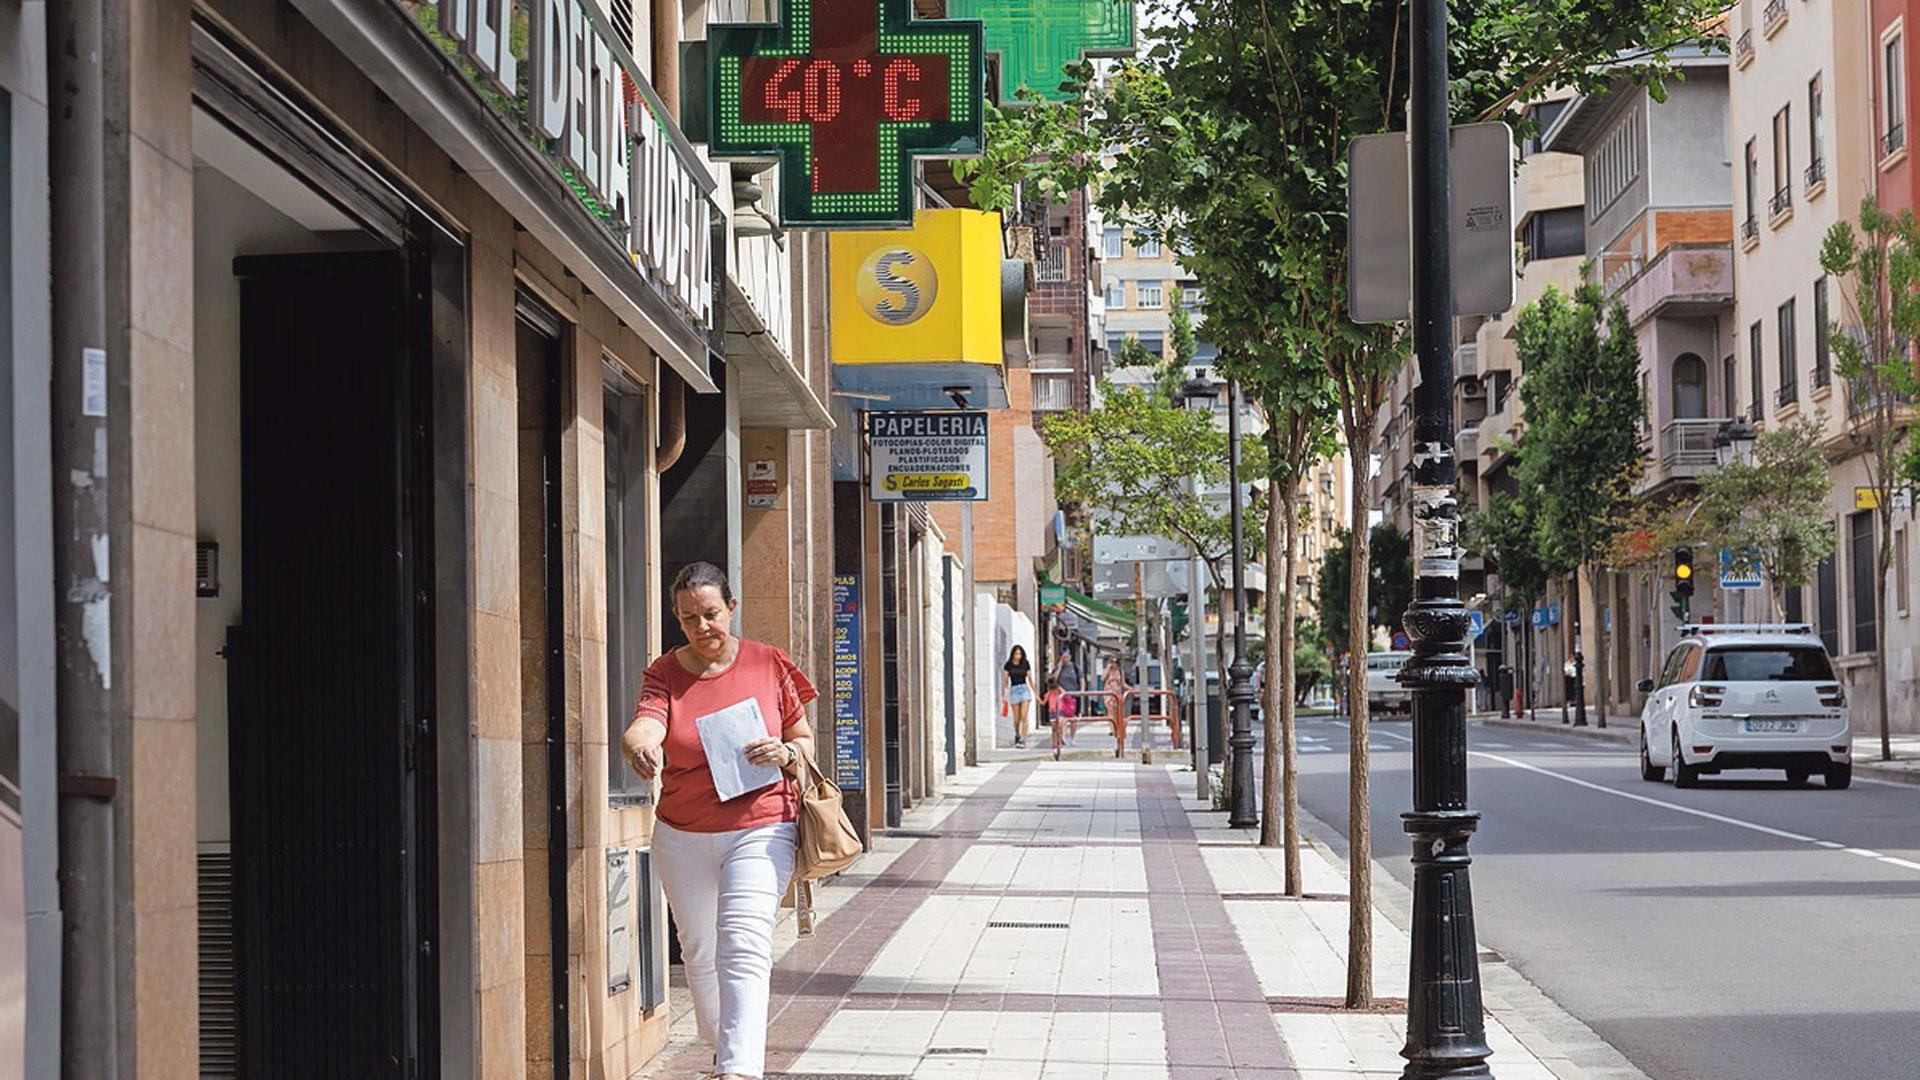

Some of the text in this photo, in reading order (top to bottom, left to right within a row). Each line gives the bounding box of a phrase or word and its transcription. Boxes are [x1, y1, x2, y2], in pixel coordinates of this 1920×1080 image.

[876, 249, 918, 321] S
[874, 417, 985, 435] PAPELERIA
[954, 438, 985, 446] DIGITAL
[888, 464, 970, 472] ENCUADERNACIONES
[902, 476, 930, 487] Carlos
